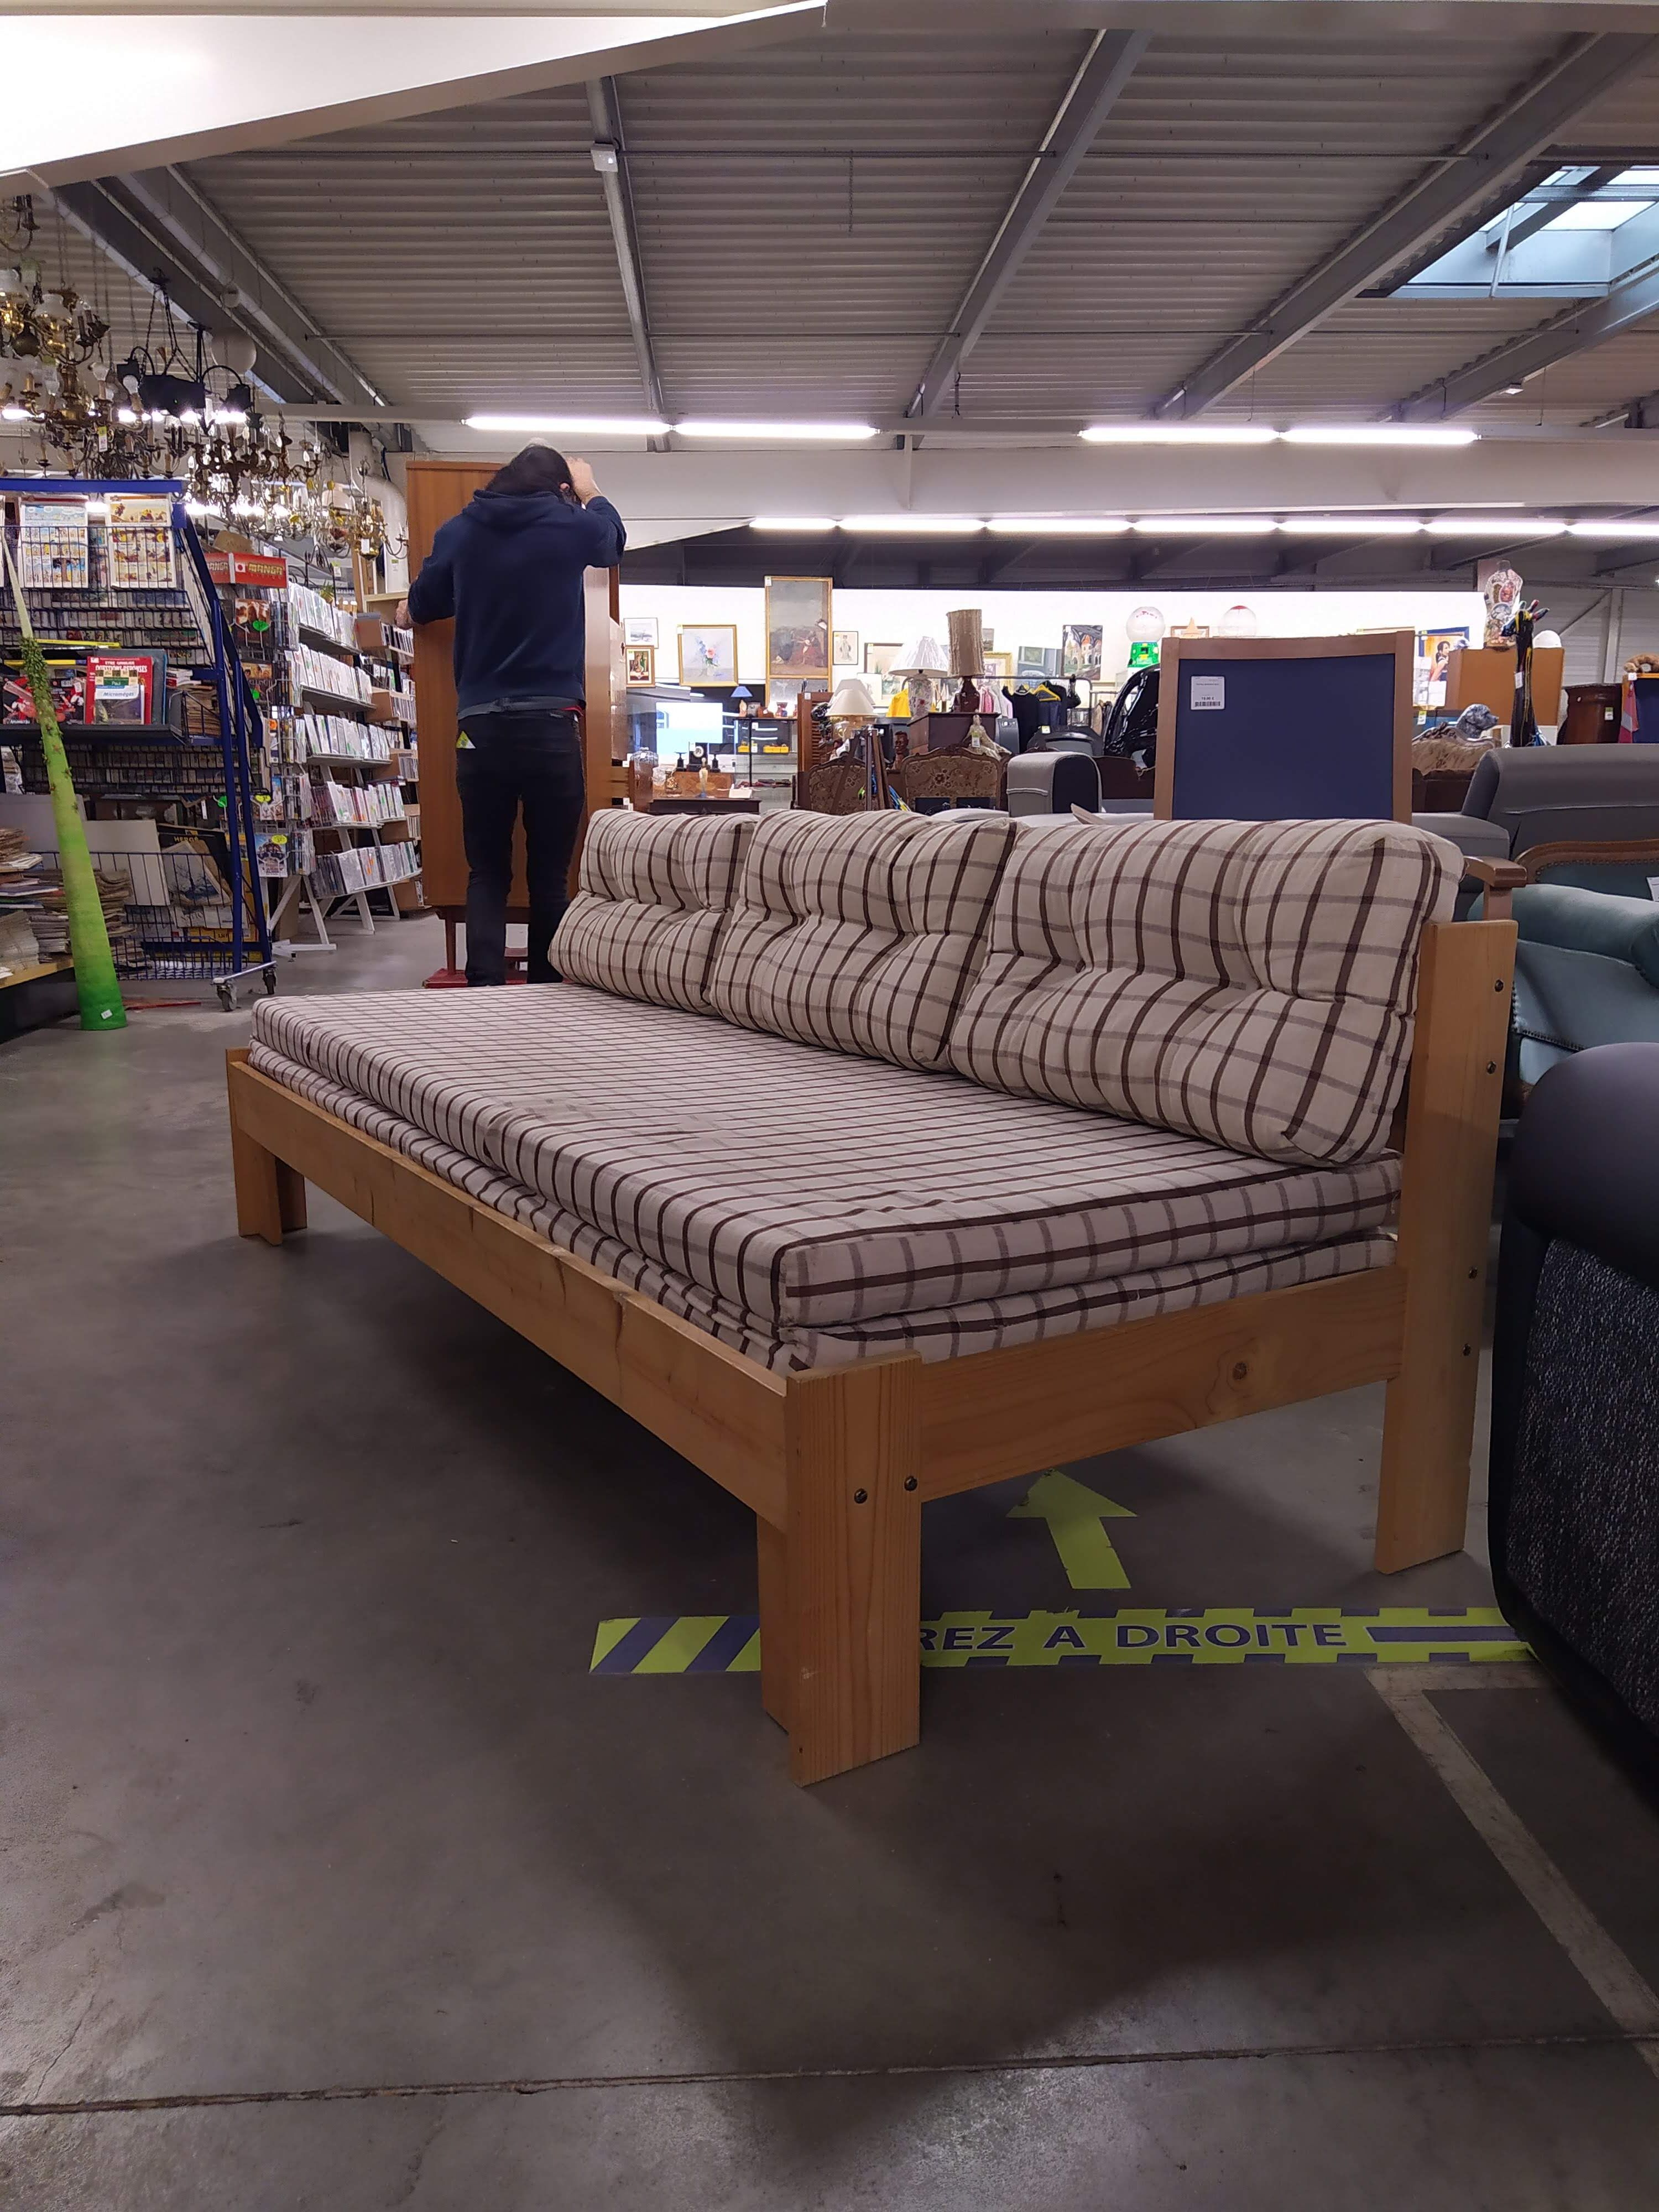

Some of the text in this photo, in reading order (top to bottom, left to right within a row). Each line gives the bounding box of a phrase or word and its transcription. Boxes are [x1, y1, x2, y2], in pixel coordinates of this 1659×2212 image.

[249, 562, 283, 575] MANGA
[920, 1623, 1347, 1651] REZ A DROITE
